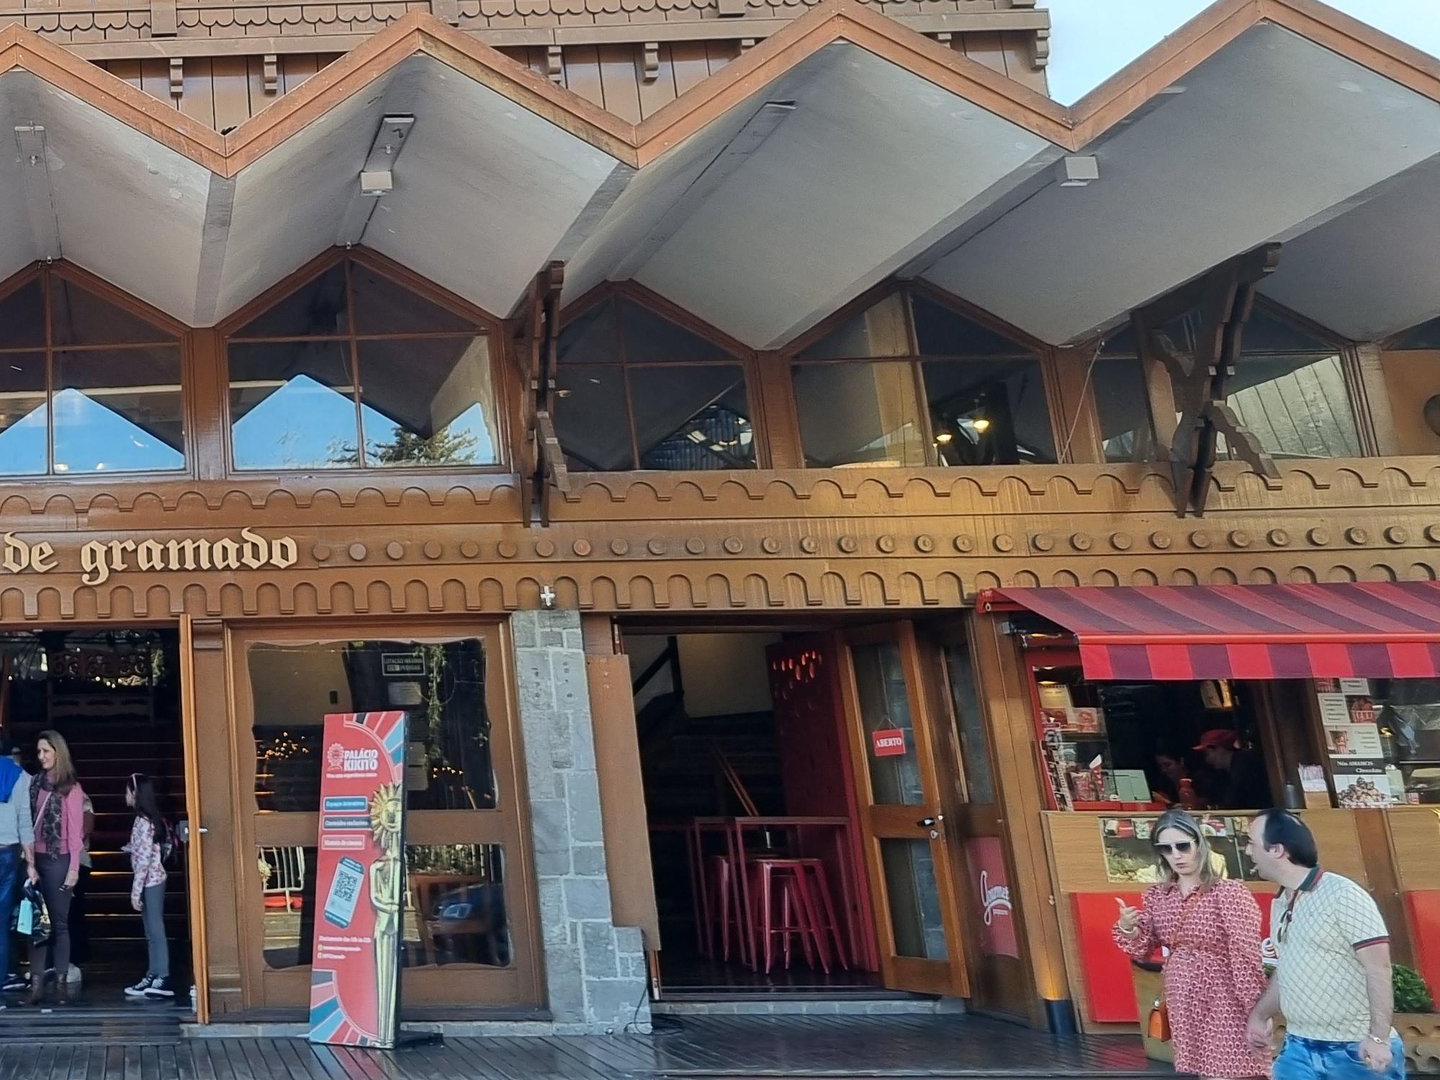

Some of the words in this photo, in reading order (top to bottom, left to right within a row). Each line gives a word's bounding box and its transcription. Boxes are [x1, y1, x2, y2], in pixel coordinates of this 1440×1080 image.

[2, 530, 59, 574] de
[80, 526, 299, 586] gramado
[344, 747, 378, 759] PALÁCIO
[343, 759, 378, 771] KIKITO
